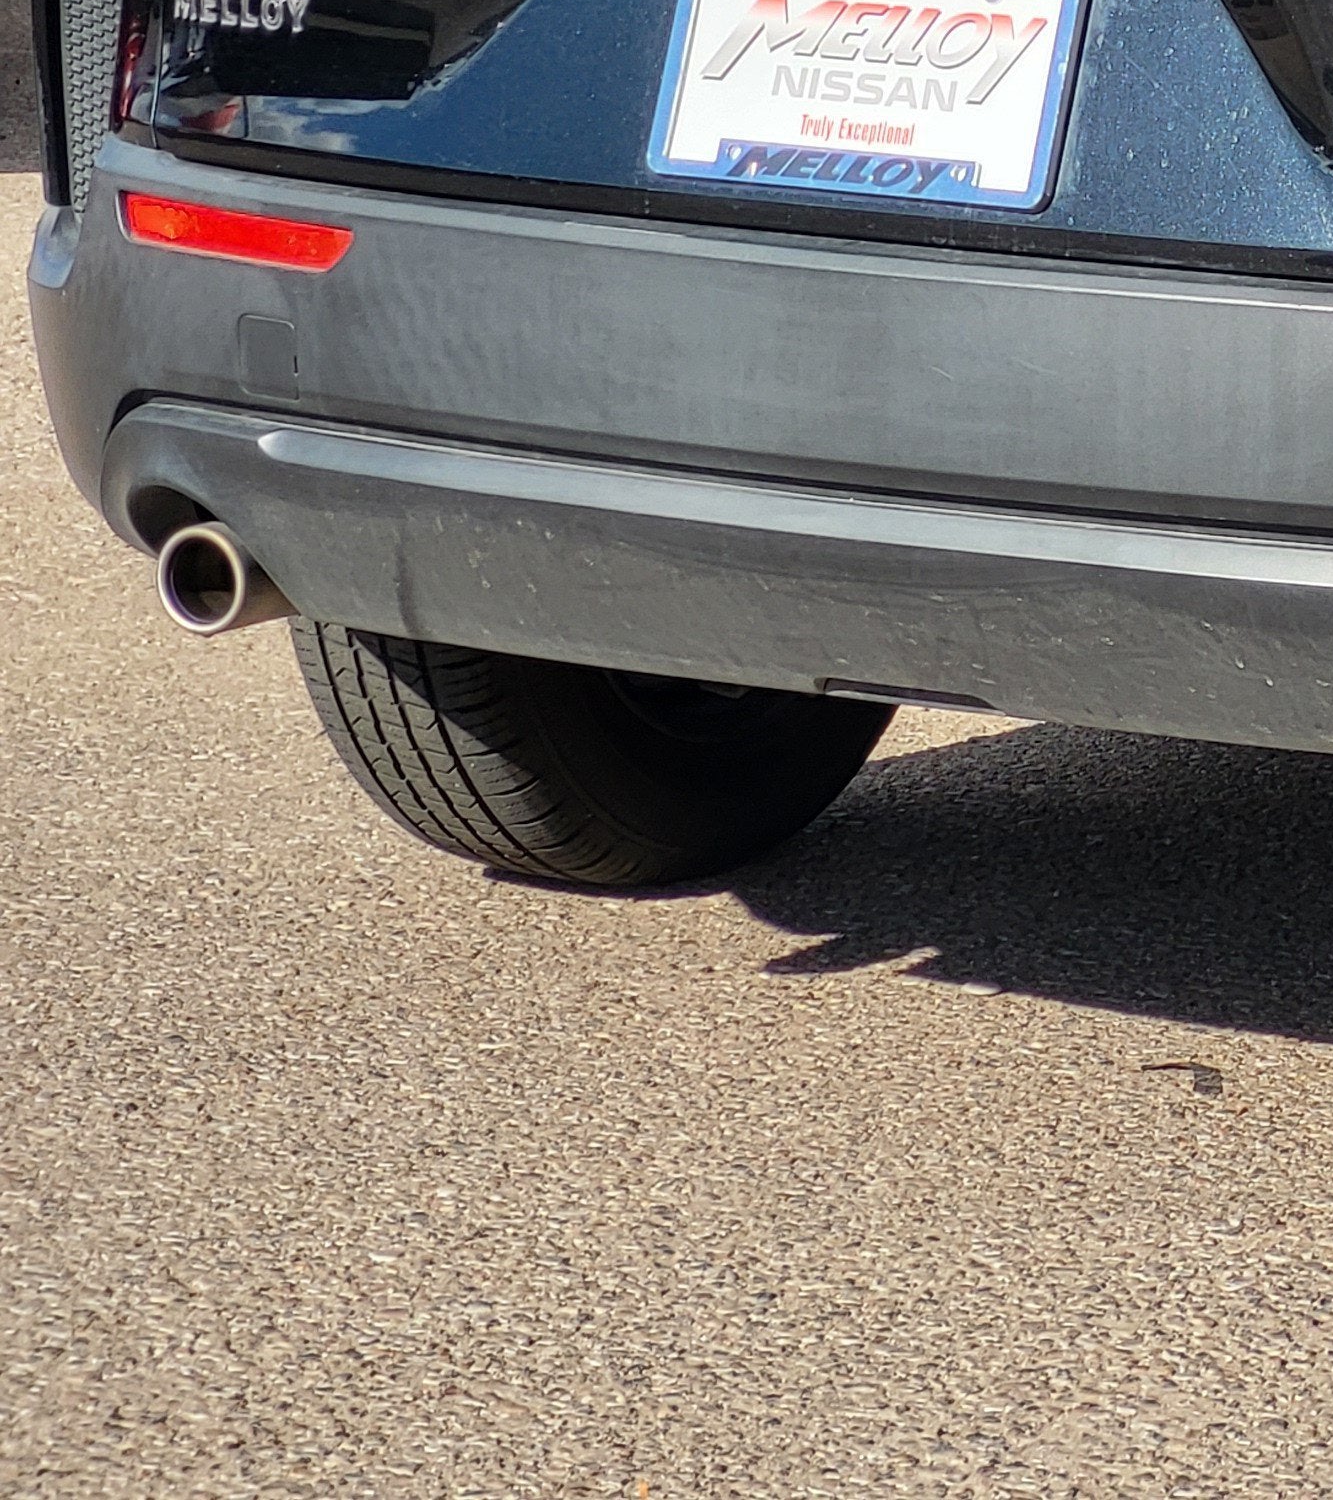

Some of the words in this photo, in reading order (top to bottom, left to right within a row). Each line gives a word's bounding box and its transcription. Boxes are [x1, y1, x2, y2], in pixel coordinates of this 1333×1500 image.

[772, 65, 958, 112] NISSAN
[801, 113, 834, 142] Truly
[838, 117, 916, 146] Exceptional
[726, 145, 949, 193] MELLOY
